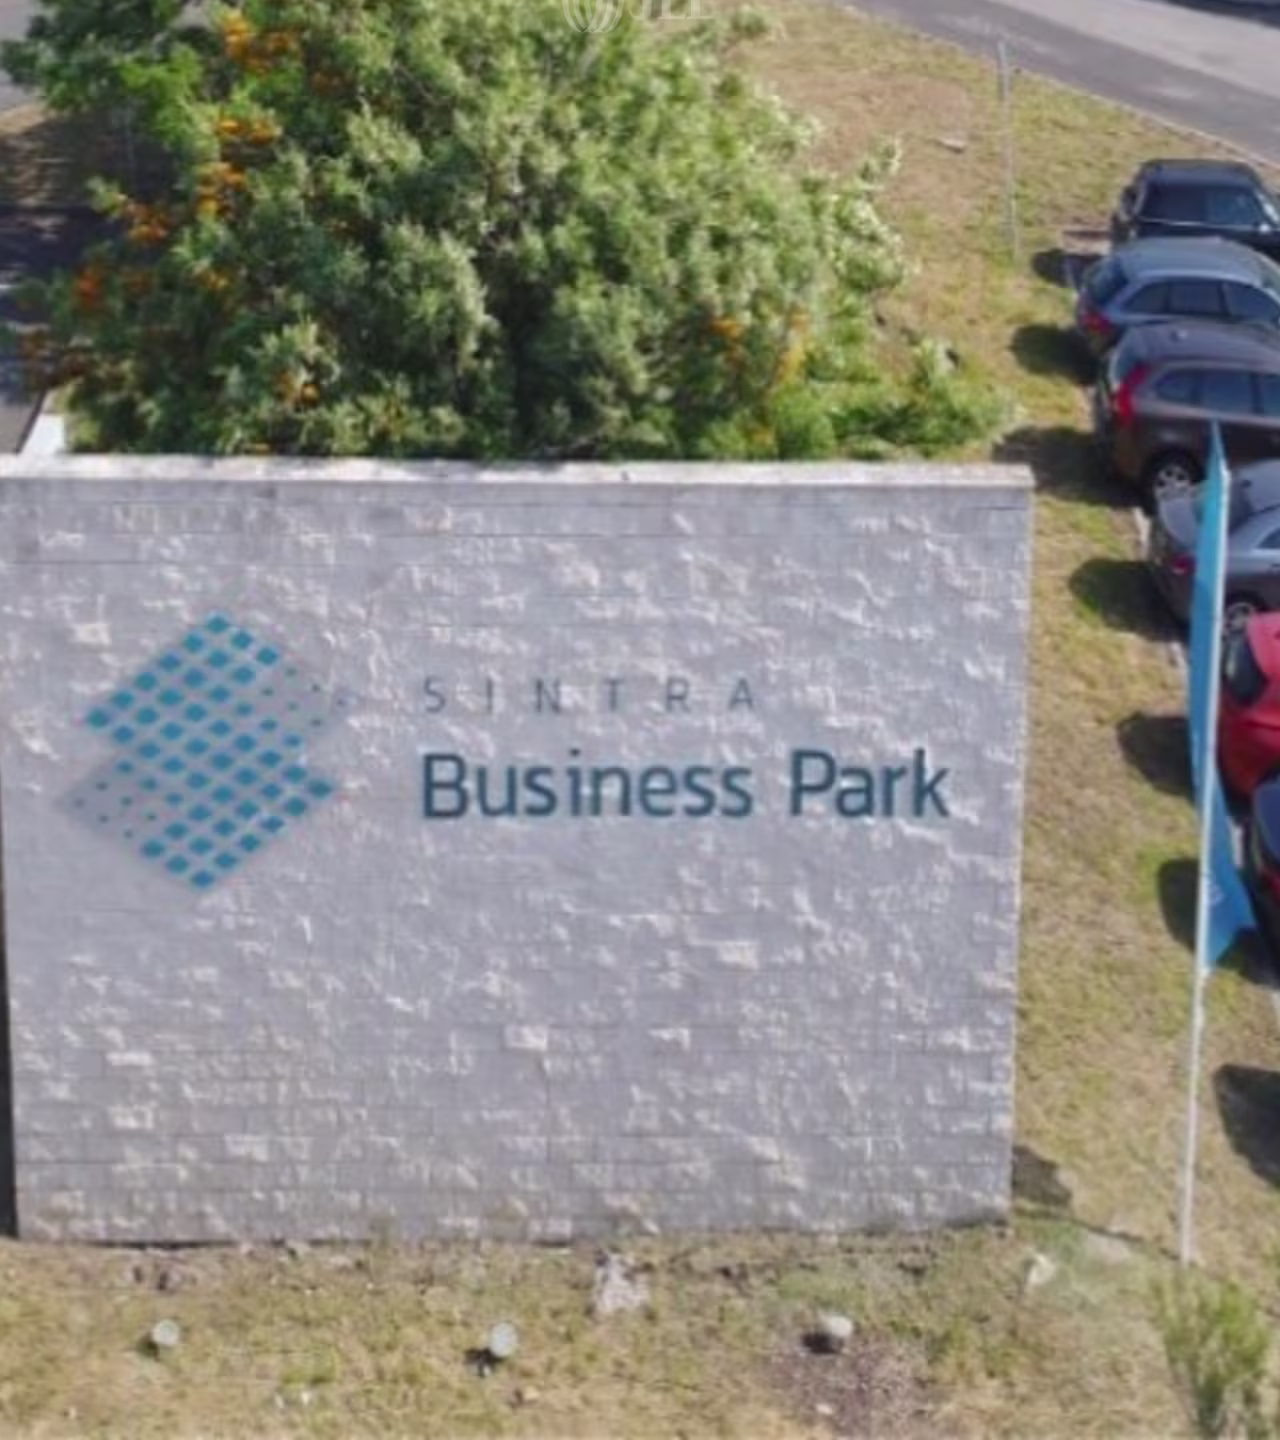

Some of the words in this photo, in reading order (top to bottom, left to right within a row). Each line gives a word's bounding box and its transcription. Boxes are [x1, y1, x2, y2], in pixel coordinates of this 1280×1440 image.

[422, 677, 757, 713] SINTRA
[422, 749, 753, 818] Business
[789, 748, 951, 817] Park
